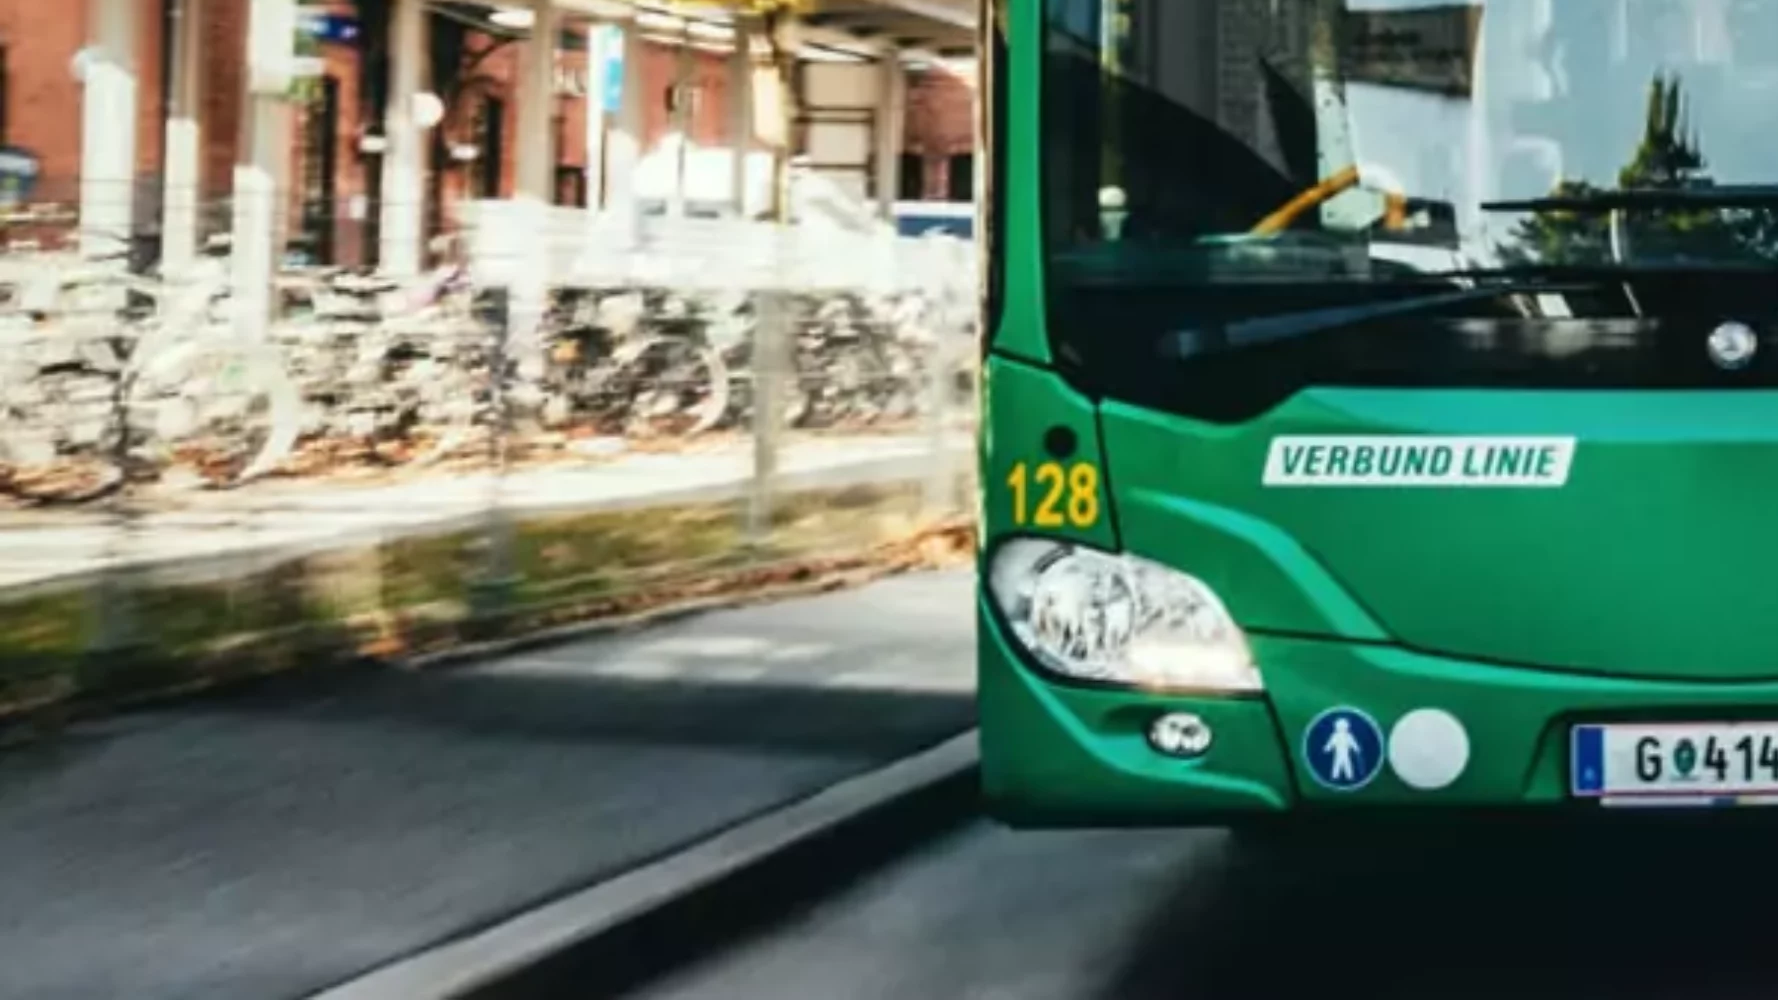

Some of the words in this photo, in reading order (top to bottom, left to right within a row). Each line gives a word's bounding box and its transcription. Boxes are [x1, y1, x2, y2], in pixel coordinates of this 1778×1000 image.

[1281, 445, 1452, 477] VERBUND
[1462, 445, 1556, 477] LINIE
[1008, 461, 1098, 527] 128
